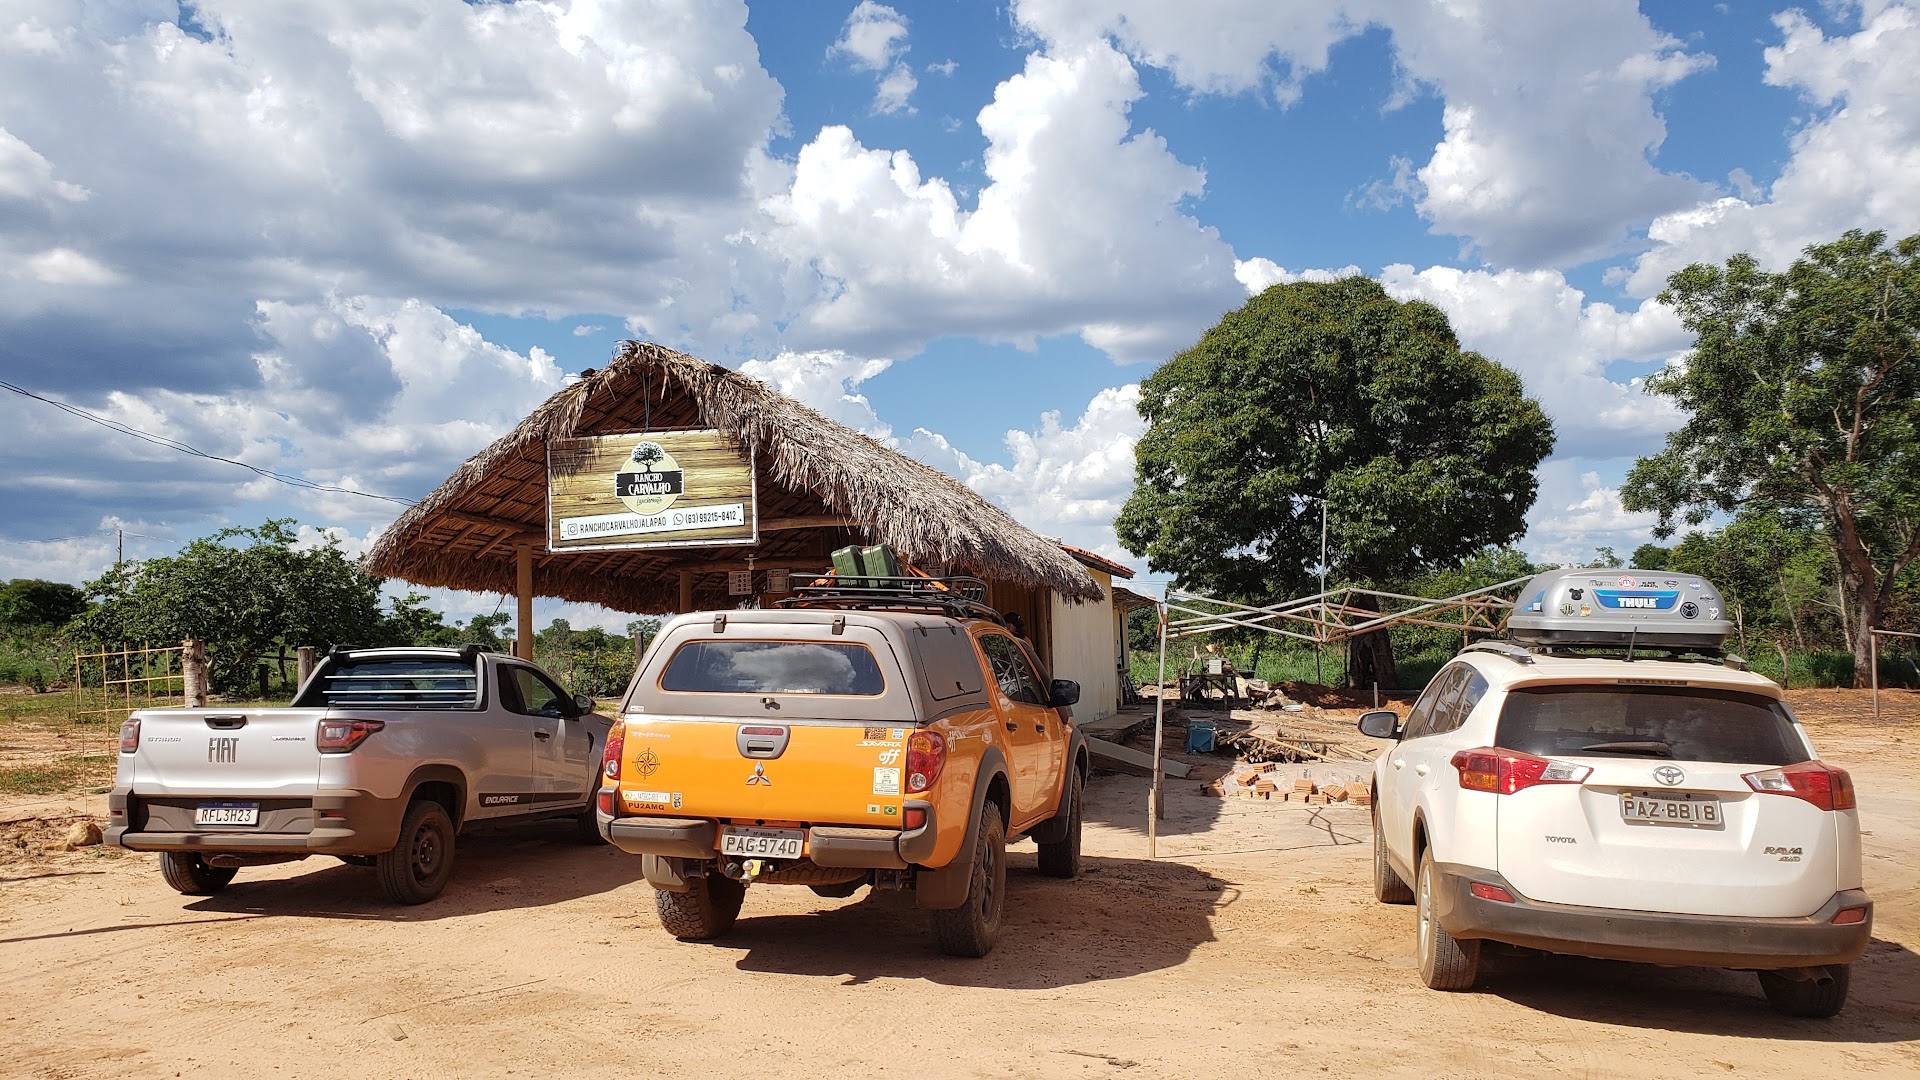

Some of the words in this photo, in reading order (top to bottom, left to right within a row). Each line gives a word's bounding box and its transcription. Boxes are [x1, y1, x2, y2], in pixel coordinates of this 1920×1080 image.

[634, 473, 663, 483] RANCHO
[628, 482, 671, 495] CARVALHO
[580, 516, 667, 533] RANCHOCARVALHOJALAPAO
[1617, 597, 1657, 608] THULE
[208, 737, 240, 763] FIAT
[878, 748, 902, 766] off
[485, 795, 520, 804] ENDURANCE
[628, 802, 665, 811] PU2AMQ
[201, 809, 252, 822] RFL3H23
[1544, 835, 1578, 845] TOYOTA
[1763, 846, 1804, 856] RAV4
